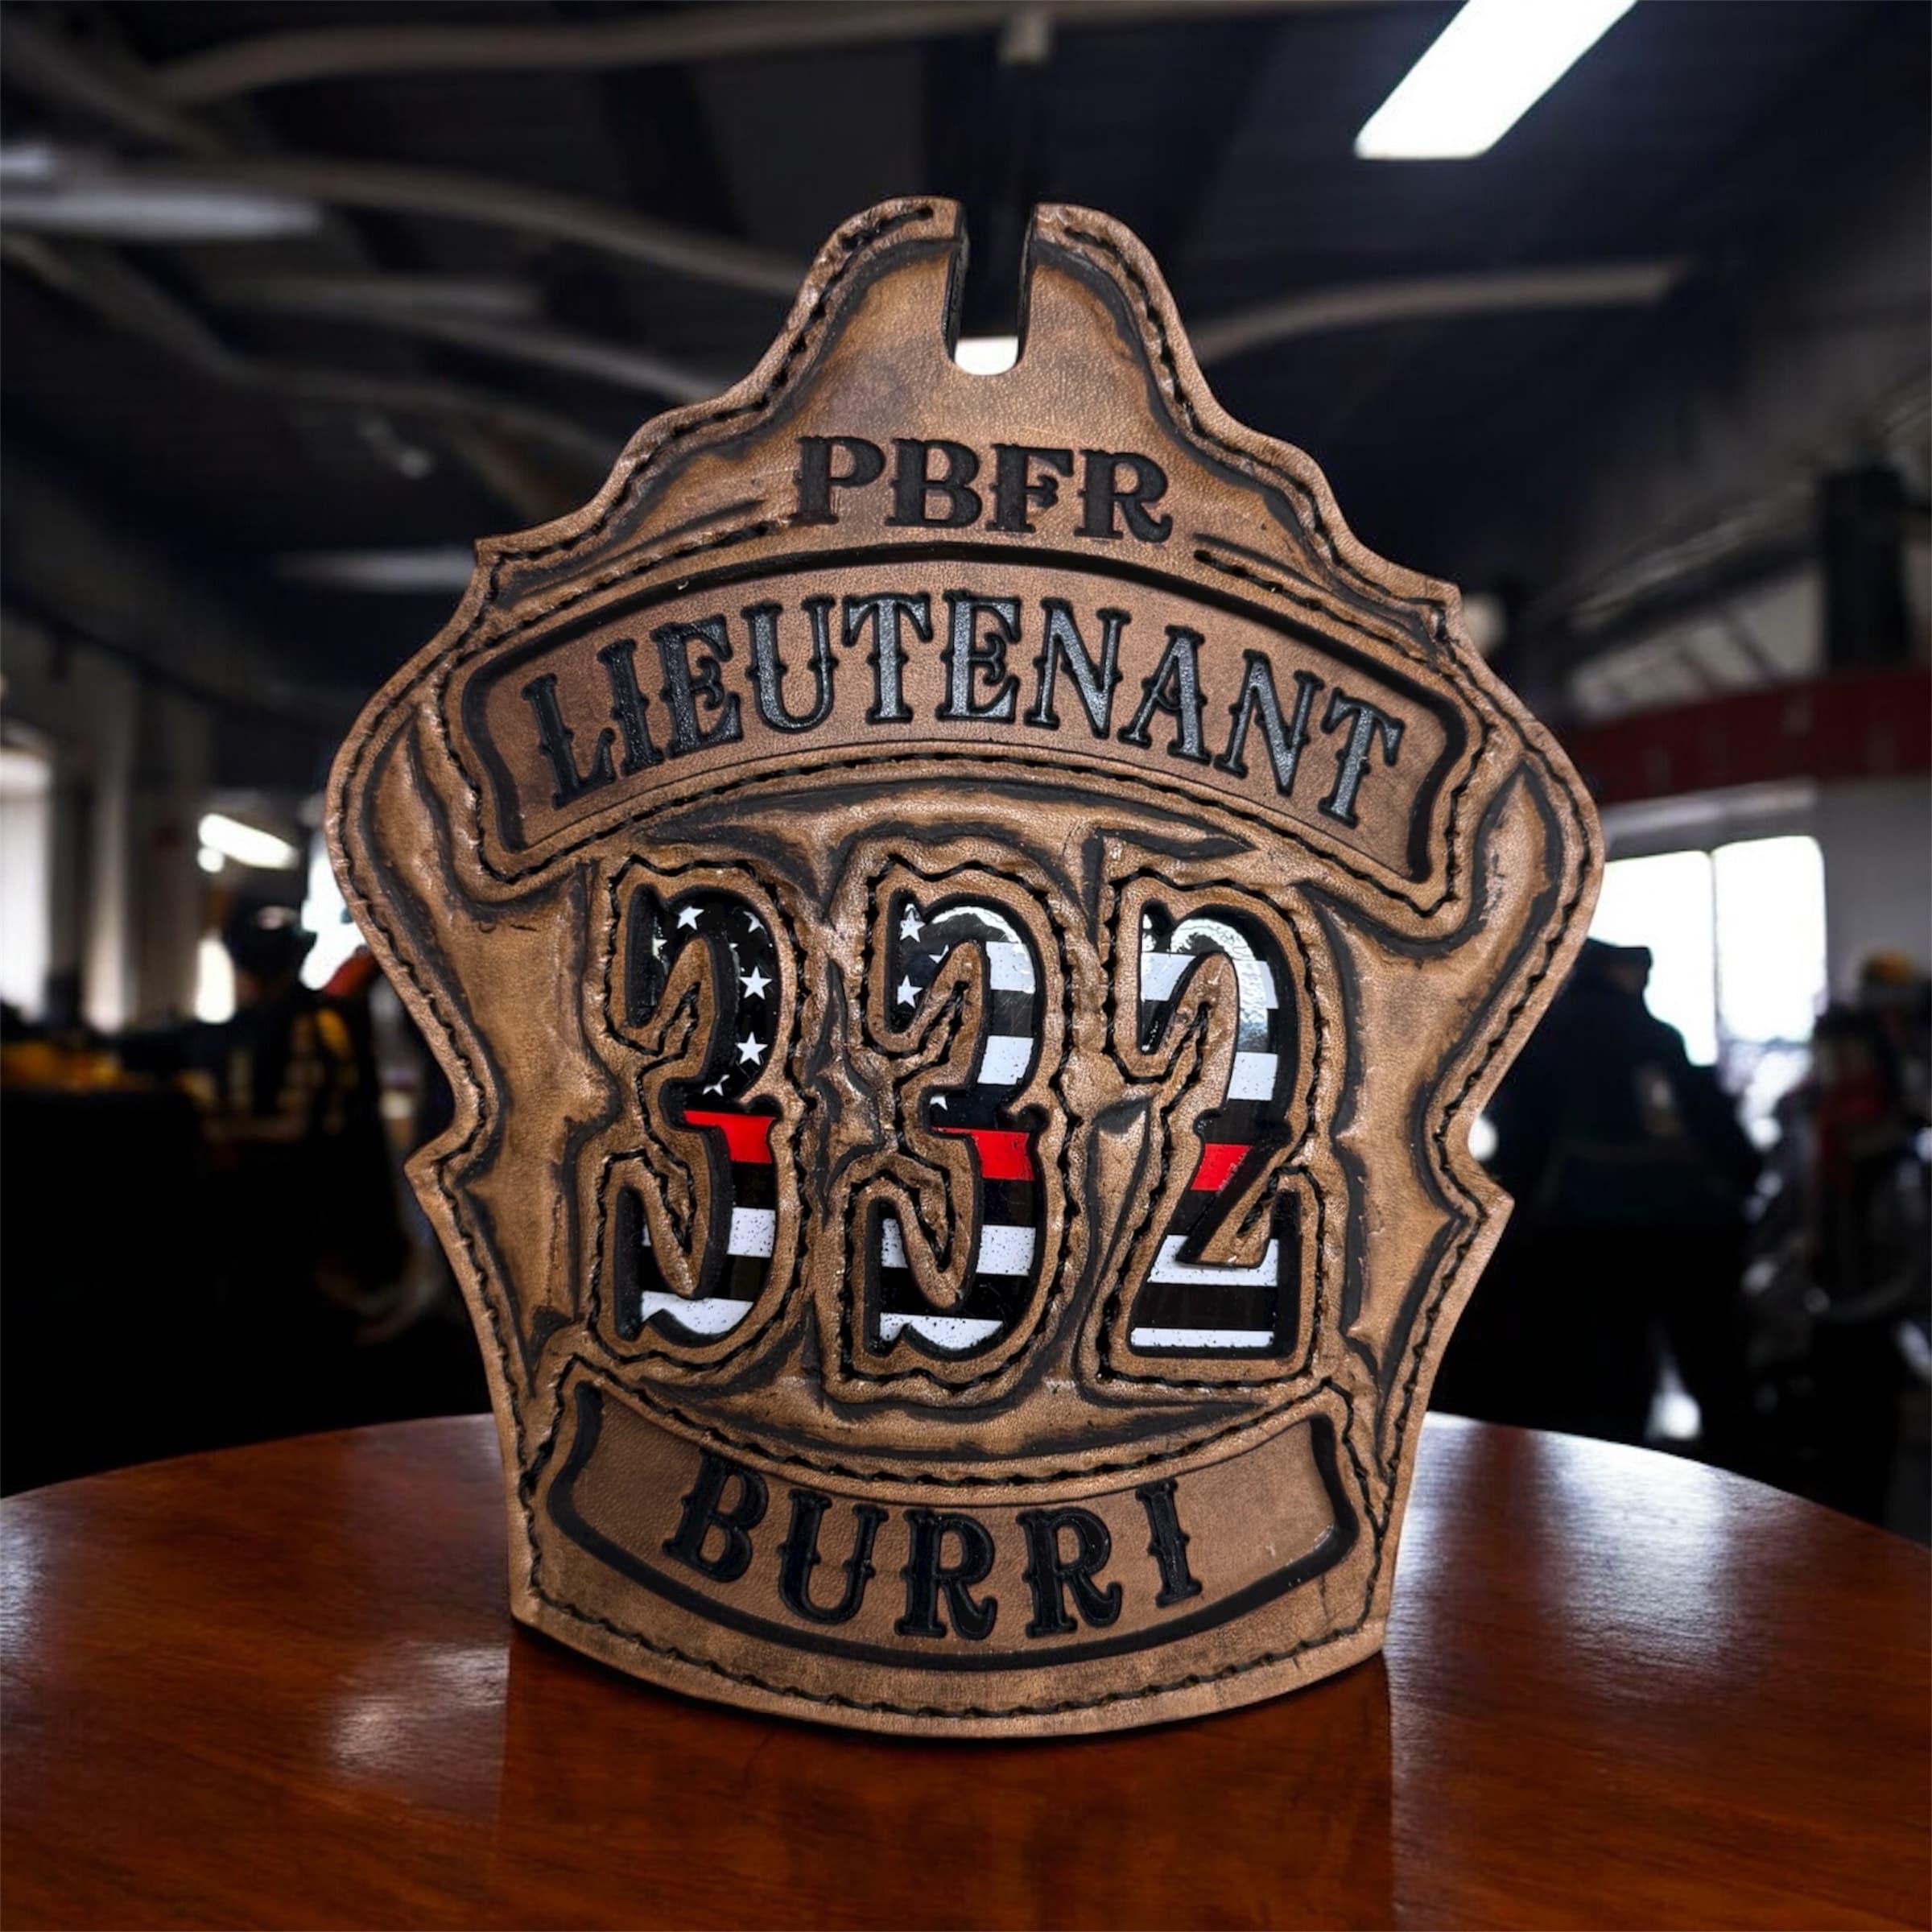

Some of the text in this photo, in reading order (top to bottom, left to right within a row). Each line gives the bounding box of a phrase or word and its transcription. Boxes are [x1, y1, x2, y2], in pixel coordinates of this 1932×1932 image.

[794, 434, 1172, 542] PBFR
[525, 592, 1404, 820] LIEUTENANT
[618, 889, 1283, 1356] 332
[665, 1457, 1201, 1639] BURRI
